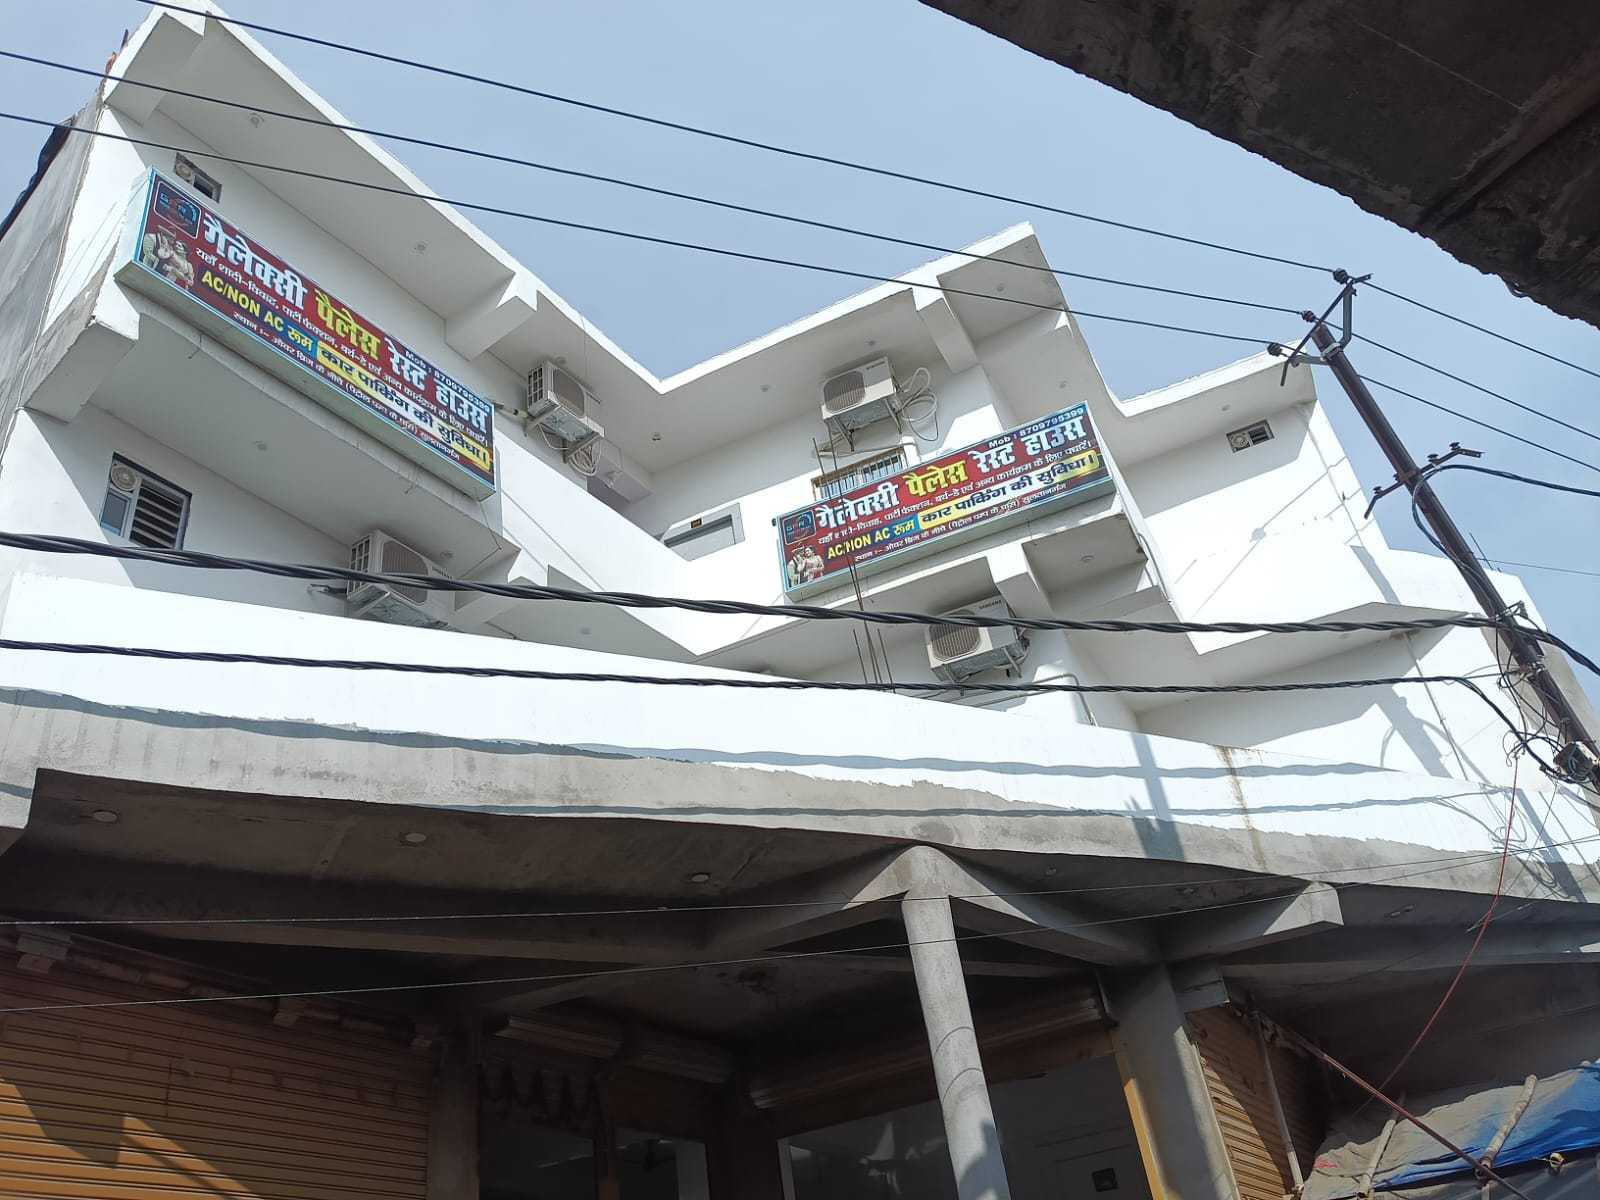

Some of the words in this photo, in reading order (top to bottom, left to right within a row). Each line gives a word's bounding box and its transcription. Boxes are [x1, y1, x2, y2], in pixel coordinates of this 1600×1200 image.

[200, 210, 308, 313] गैलेक्सी
[311, 287, 381, 362] पैलेस
[382, 336, 427, 394] रेस्ट
[432, 376, 487, 434] हाउस
[200, 266, 261, 319] AC/NON
[263, 307, 285, 334] AC
[286, 323, 313, 353] रूम
[319, 345, 356, 377] कार
[412, 403, 433, 428] की
[814, 481, 898, 528] गैलेक्सी
[902, 459, 968, 496] पैलेस
[967, 441, 1016, 473] रेस्ट
[1020, 415, 1086, 456] हाउस
[987, 434, 1011, 449] Mob
[825, 531, 872, 560] AC/NON
[872, 525, 891, 543] AC
[891, 517, 916, 537] रूम
[921, 504, 953, 525] कार
[1008, 473, 1034, 493] की
